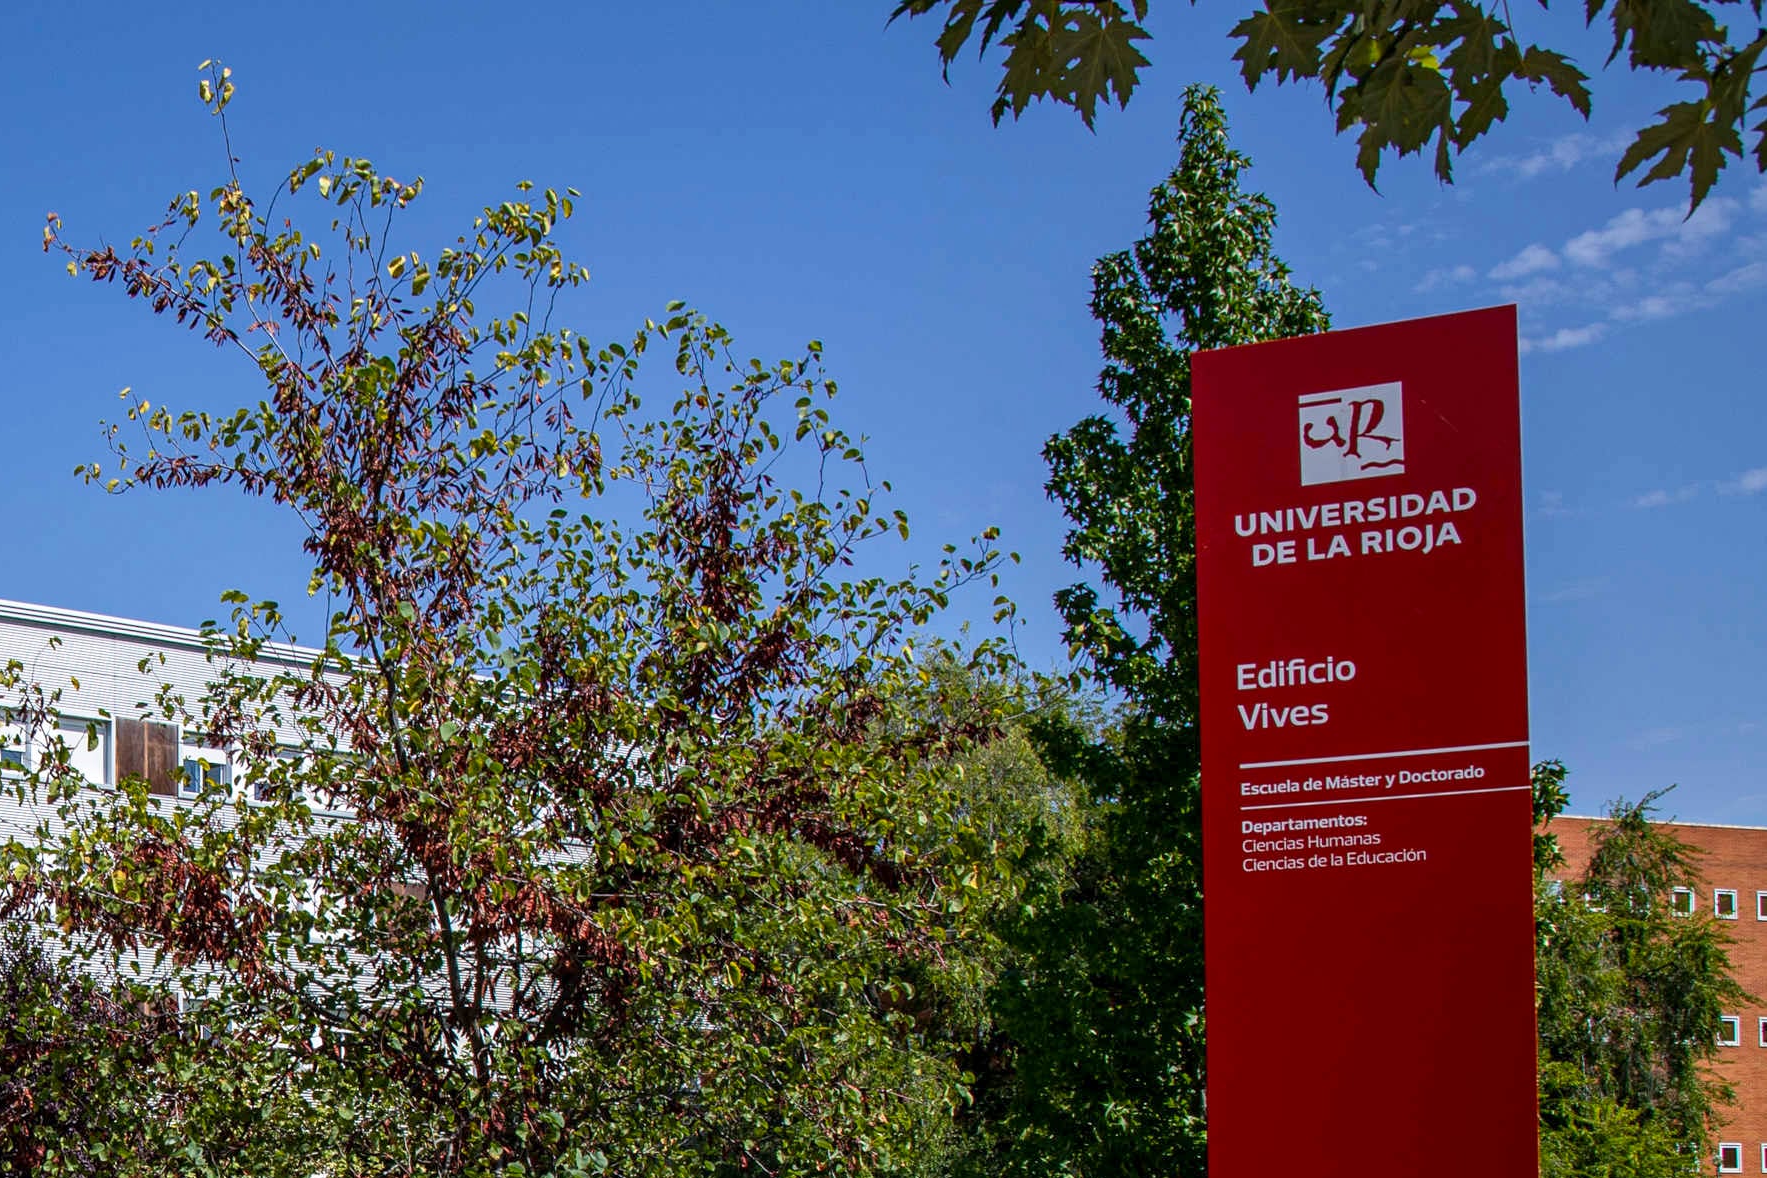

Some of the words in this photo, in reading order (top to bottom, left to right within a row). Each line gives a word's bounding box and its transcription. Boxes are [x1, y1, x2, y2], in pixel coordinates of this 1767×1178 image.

[1234, 487, 1477, 537] UNIVERSIDAD
[1252, 540, 1297, 567] DE
[1307, 534, 1352, 562] LA
[1361, 521, 1462, 556] RIOJA
[1236, 655, 1356, 691] Edificio
[1237, 702, 1329, 731] Vives
[1240, 779, 1300, 796] Escuela
[1302, 777, 1323, 792] de
[1325, 773, 1382, 790] Máster
[1384, 773, 1396, 789] y
[1398, 764, 1485, 785] Doctorado
[1241, 814, 1368, 836] Departamentos:
[1242, 837, 1305, 853] Ciencias
[1307, 832, 1381, 849] Humanas
[1242, 855, 1305, 873] Ciencias
[1308, 853, 1328, 868] de
[1330, 853, 1344, 867] la
[1346, 848, 1427, 866] Educación
